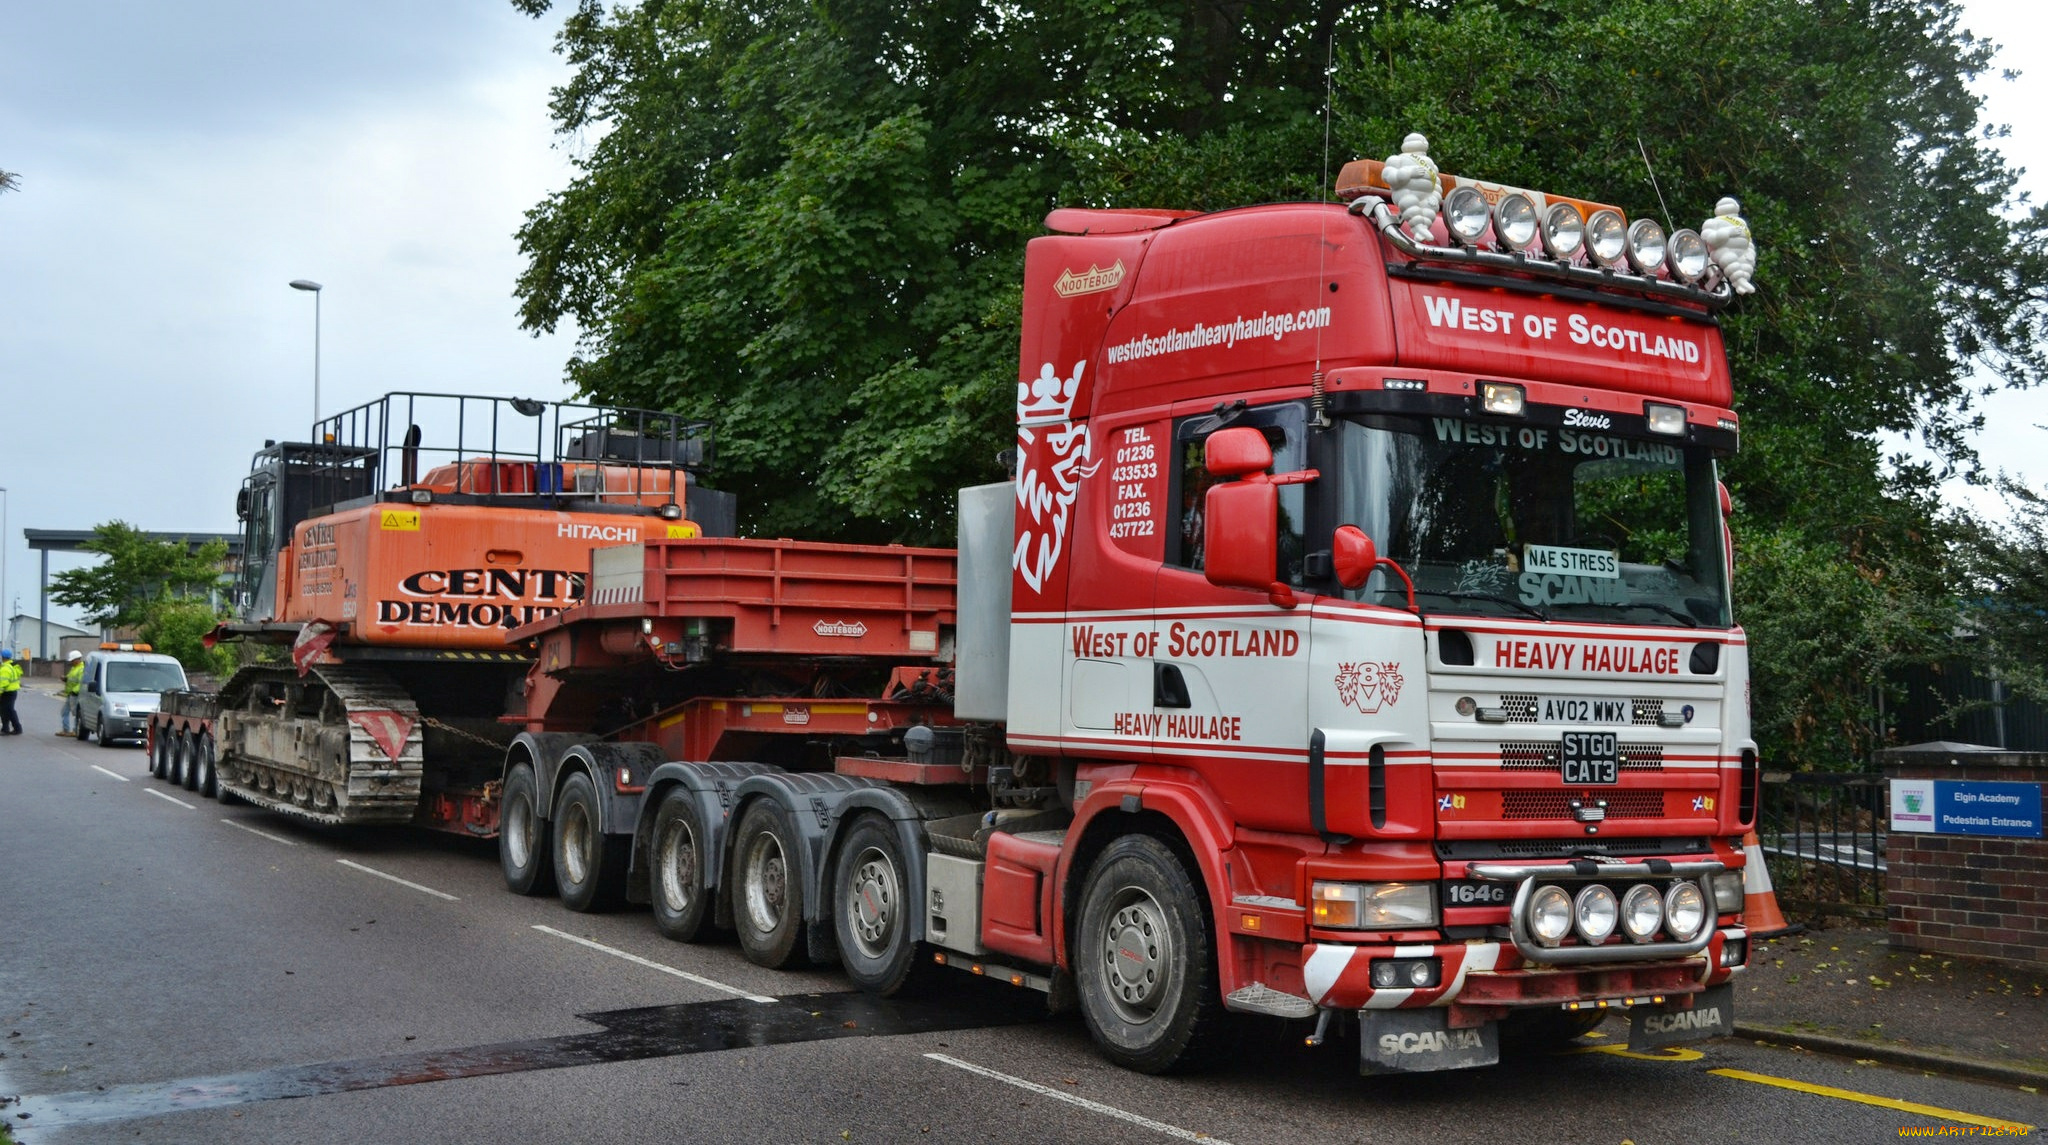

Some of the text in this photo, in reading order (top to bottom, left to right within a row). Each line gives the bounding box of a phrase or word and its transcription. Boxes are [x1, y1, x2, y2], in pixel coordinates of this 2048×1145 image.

[1061, 271, 1120, 292] NOOTEBOOM
[1108, 306, 1331, 364] westofscotlandheavyhaulage.com
[1423, 295, 1699, 364] WEST OF SCOTLAND
[1563, 408, 1611, 430] Stevie
[1124, 427, 1150, 444] TEL.
[1432, 417, 1677, 466] WEST OF SCOTLAND
[1117, 445, 1154, 464] 01236
[1112, 463, 1157, 482] 433533
[1118, 482, 1146, 500] FAX.
[1113, 501, 1151, 519] 01236
[557, 523, 637, 542] HITACHI
[1110, 519, 1154, 538] 437722
[1529, 549, 1615, 573] NAE STRESS
[376, 600, 572, 629] DEMOLIT
[817, 625, 863, 635] NOOTEBOOM
[1072, 621, 1299, 657] WEST OF SCOTLAND
[1495, 640, 1679, 675] HEAVY HAULAGE
[1545, 699, 1625, 722] AV02 WWX
[1114, 712, 1241, 741] HEAVY HAULAGE
[1954, 792, 2020, 805] Elgin Academy
[1943, 815, 1989, 826] Pedestrian
[1992, 817, 2032, 828] Entrance
[1643, 1007, 1722, 1034] SCANIA
[1379, 1029, 1483, 1056] SCANIA
